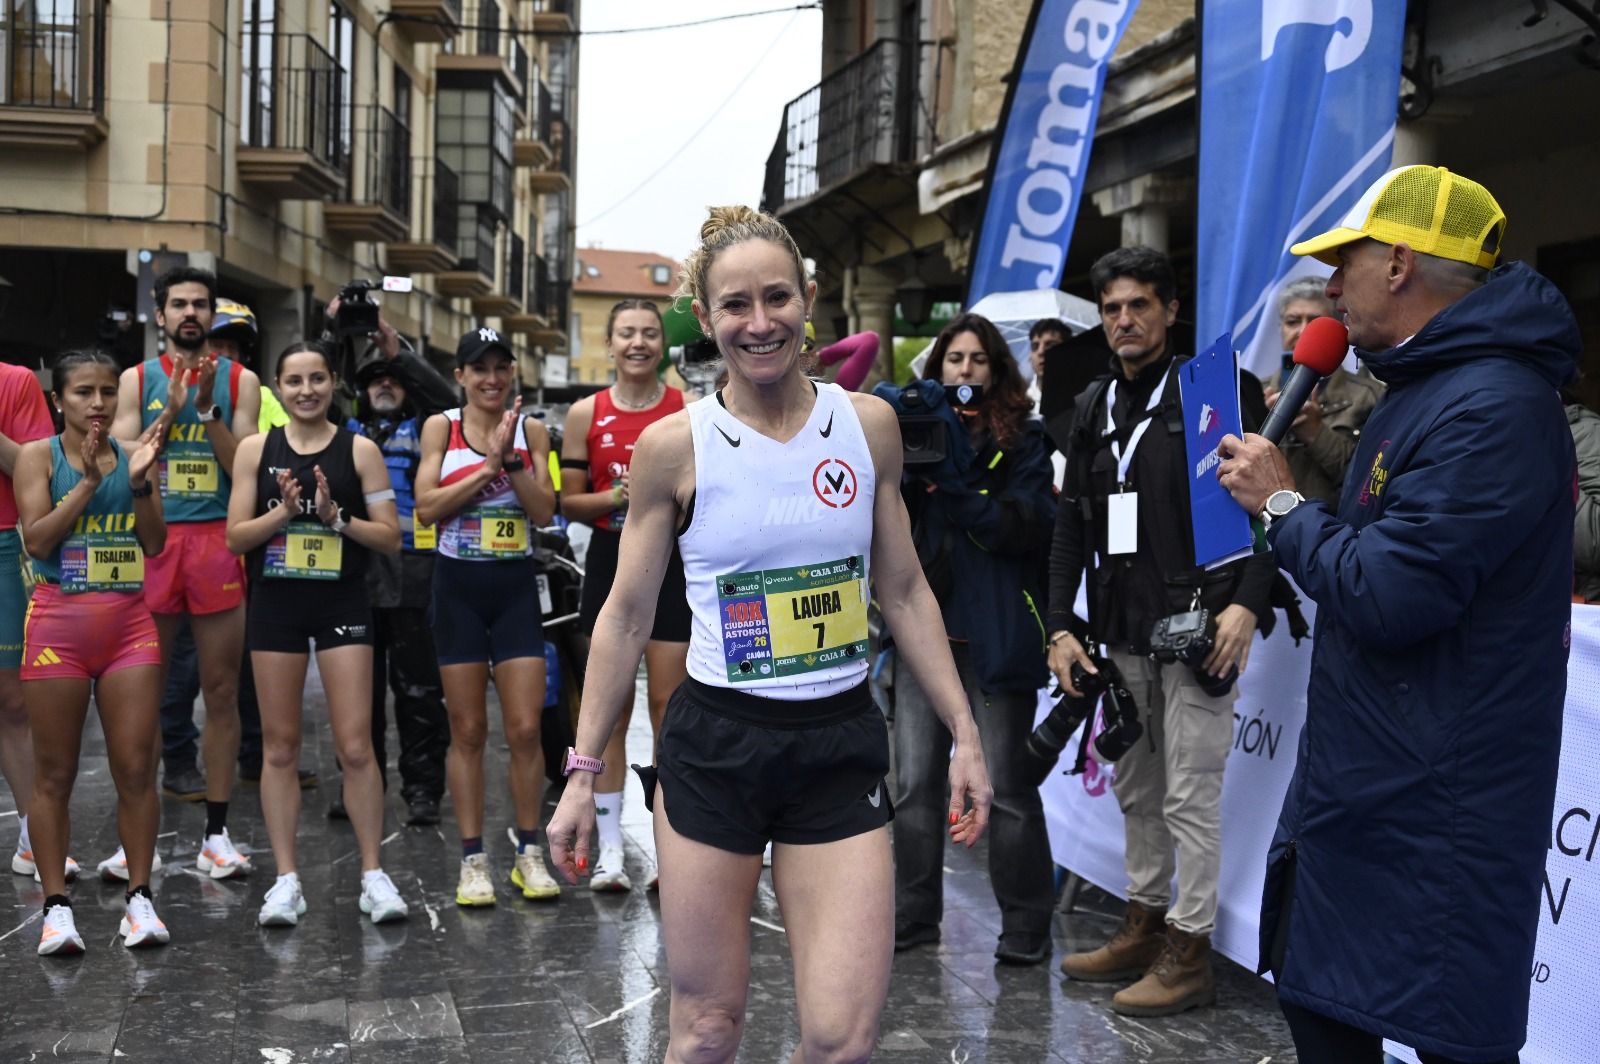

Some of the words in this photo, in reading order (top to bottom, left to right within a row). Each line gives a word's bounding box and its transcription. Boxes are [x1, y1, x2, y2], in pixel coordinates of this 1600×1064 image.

[187, 477, 196, 490] 5
[496, 520, 515, 538] 28
[303, 538, 323, 551] LUCI
[94, 550, 136, 563] TISALEMA
[307, 553, 316, 567] 6
[110, 566, 119, 580] 4
[810, 568, 832, 578] CAJA
[725, 601, 763, 623] 10K
[791, 590, 842, 620] LAURA
[724, 620, 754, 629] CIUDAD
[725, 627, 768, 639] ASTORGA
[813, 623, 825, 649] 7
[754, 636, 767, 647] 26
[820, 651, 839, 662] CAJA
[840, 644, 866, 658] RAL
[1233, 708, 1283, 760] IÓN
